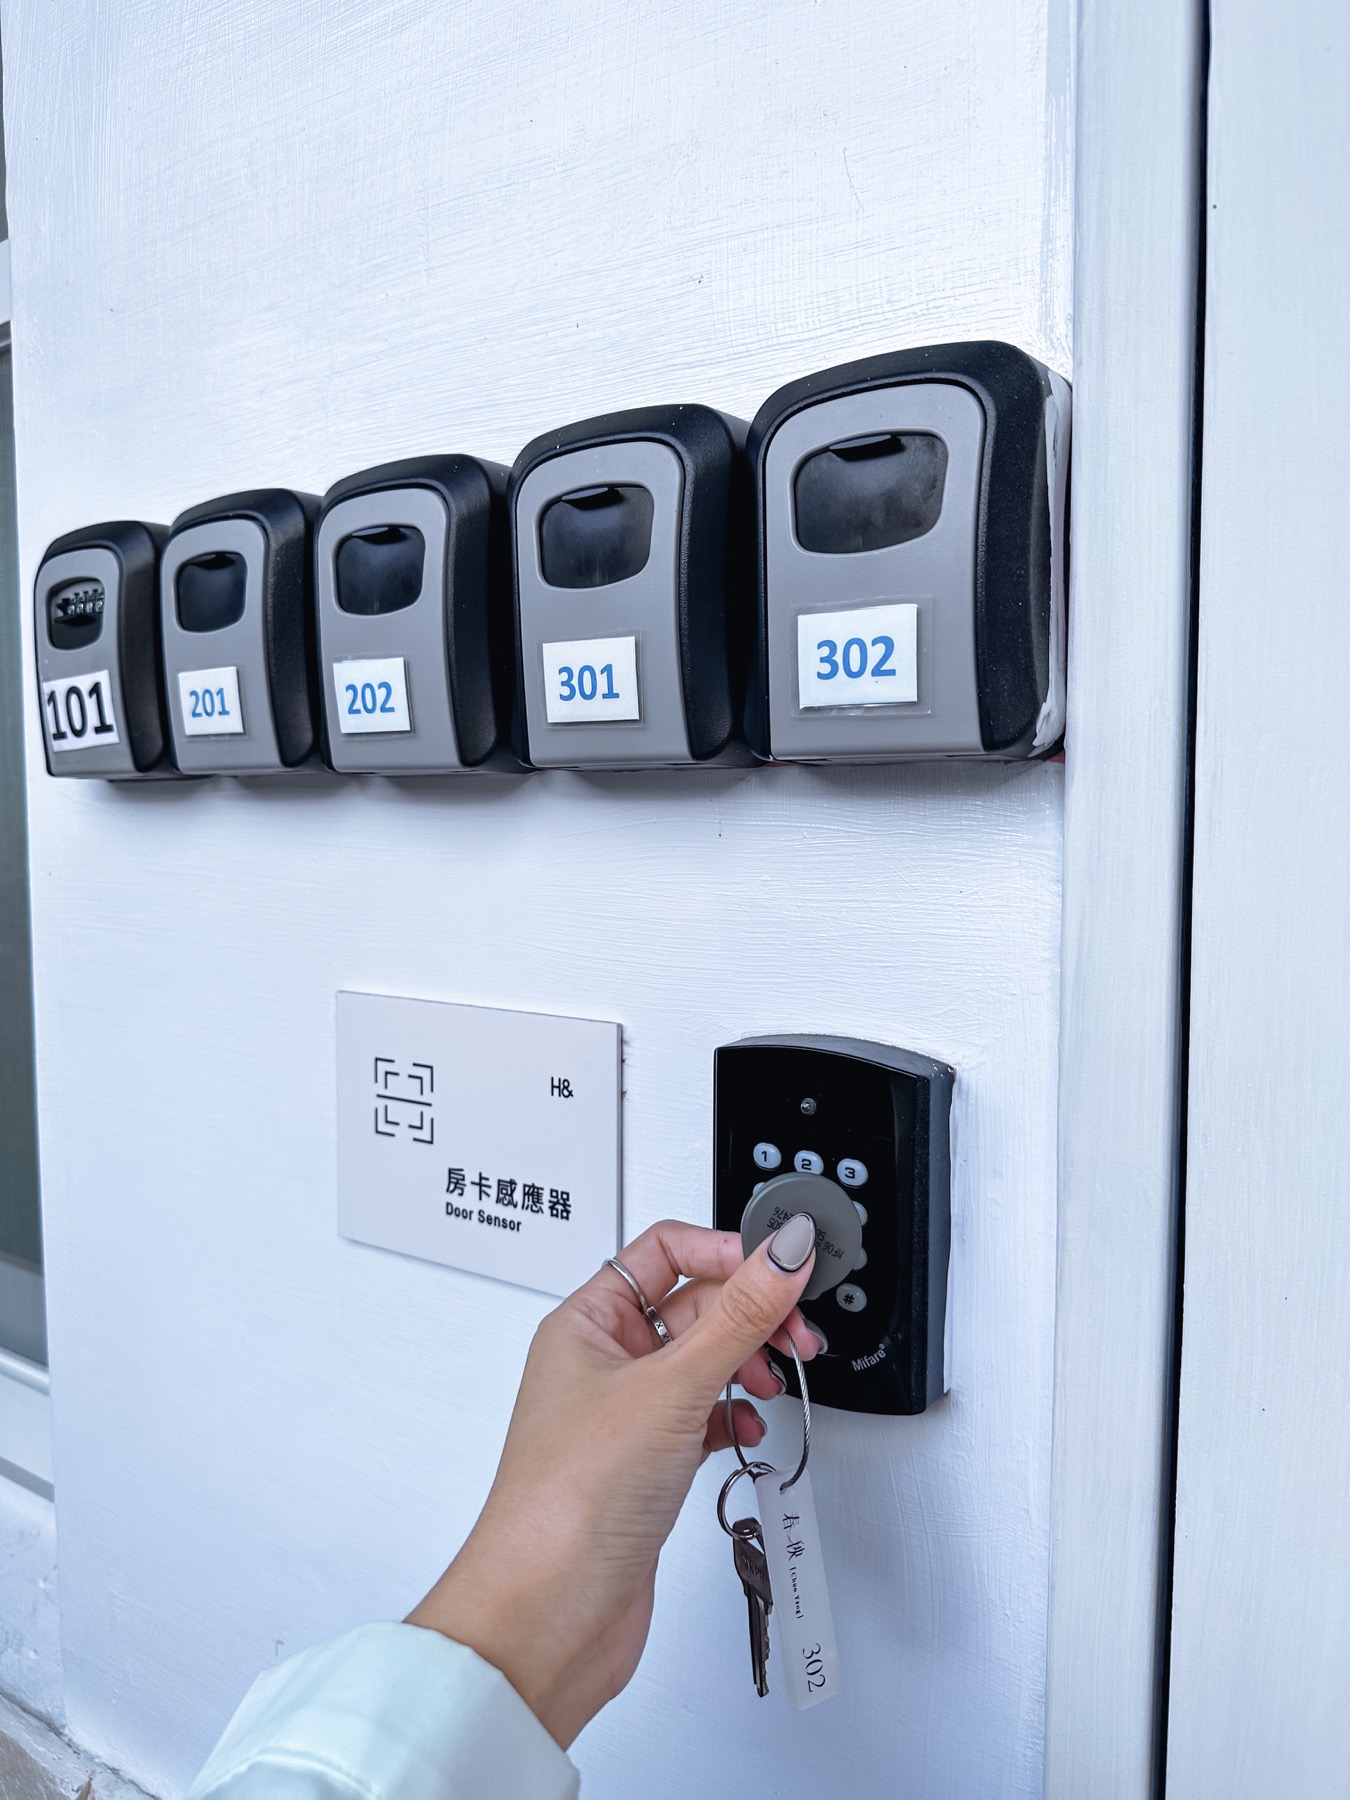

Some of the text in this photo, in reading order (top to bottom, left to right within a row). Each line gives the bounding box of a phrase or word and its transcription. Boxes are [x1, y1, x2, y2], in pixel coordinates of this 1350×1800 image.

[815, 635, 897, 681] 302
[345, 681, 396, 715] 202
[558, 664, 620, 701] 301
[47, 681, 115, 741] 101
[189, 687, 231, 718] 201
[550, 1076, 574, 1098] H&
[761, 1150, 856, 1179] 1 2 3
[446, 1167, 572, 1221] 房卡感應器
[445, 1202, 522, 1232] Door Sensor
[802, 1642, 827, 1693] 302
